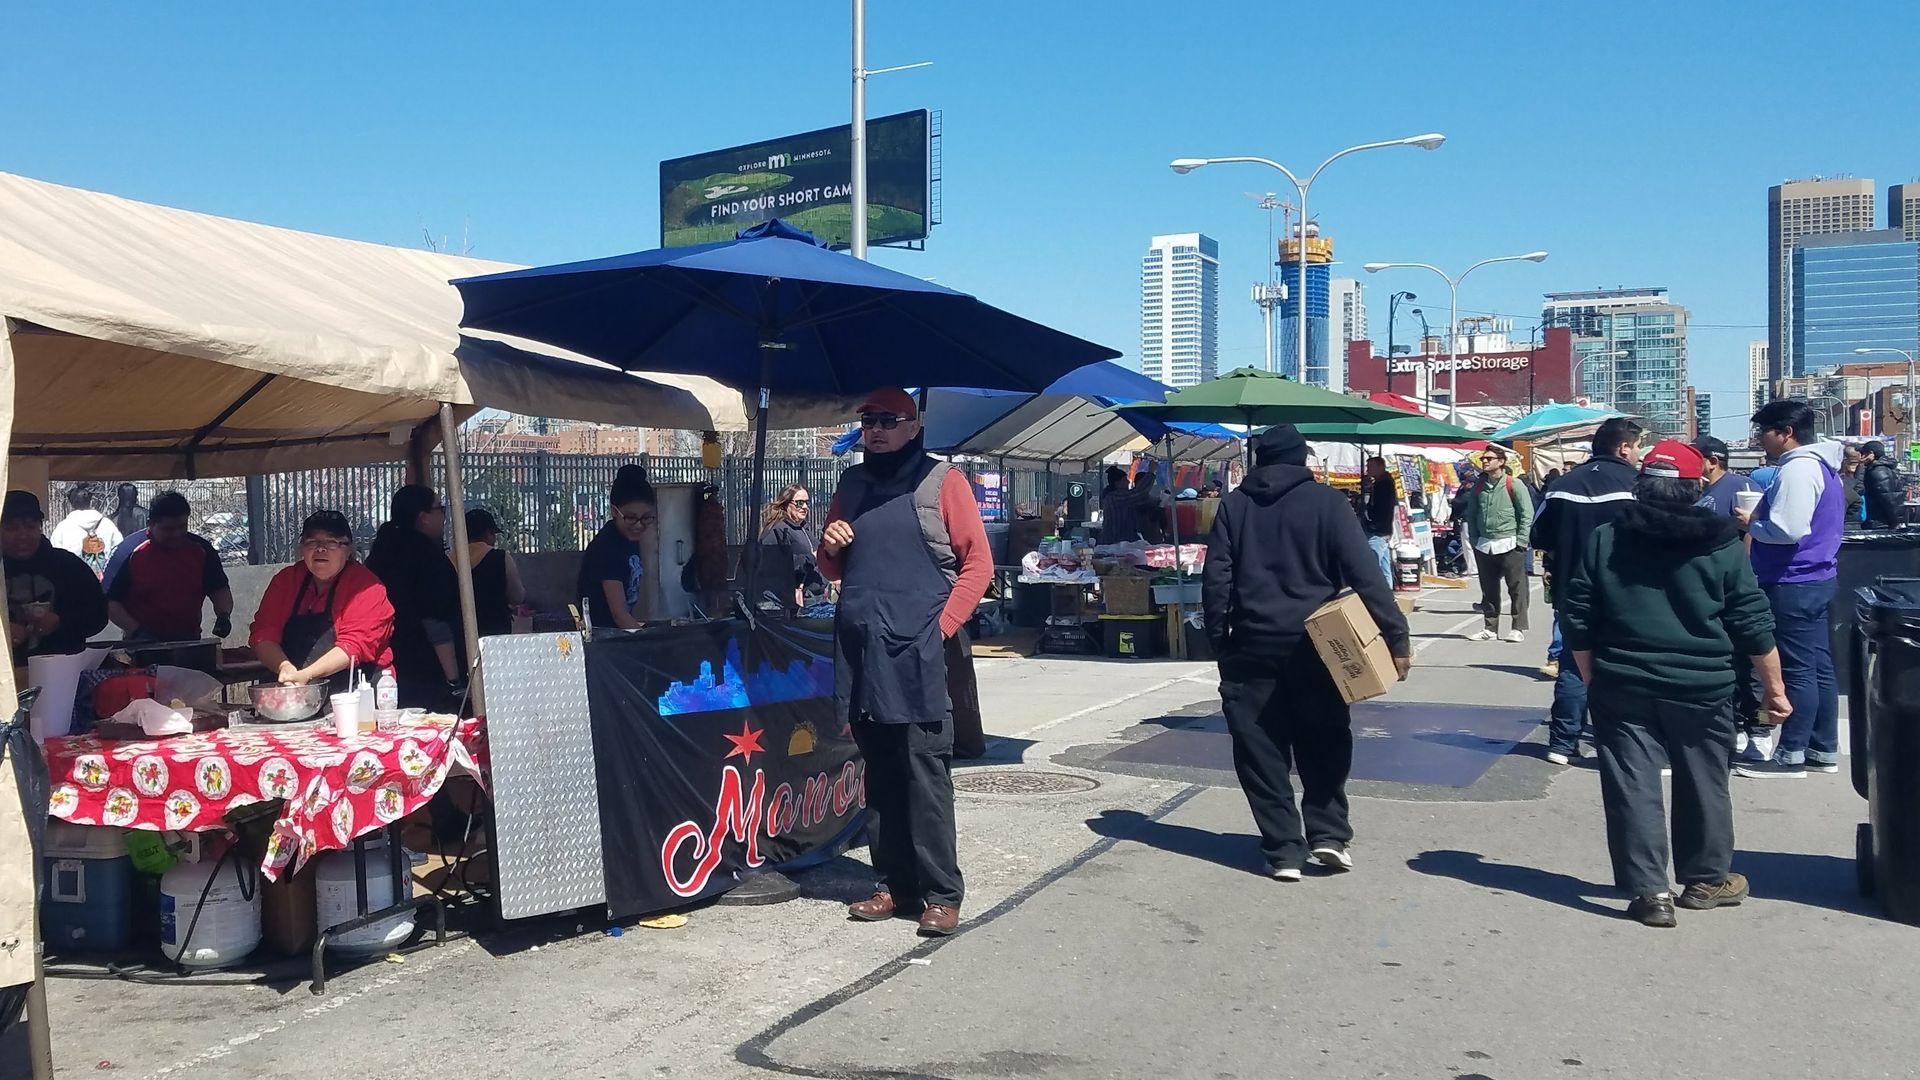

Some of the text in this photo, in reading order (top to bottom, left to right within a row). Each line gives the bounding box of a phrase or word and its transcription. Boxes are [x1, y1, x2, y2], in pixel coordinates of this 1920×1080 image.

[711, 183, 852, 218] FIND YOUR SHORT GAM
